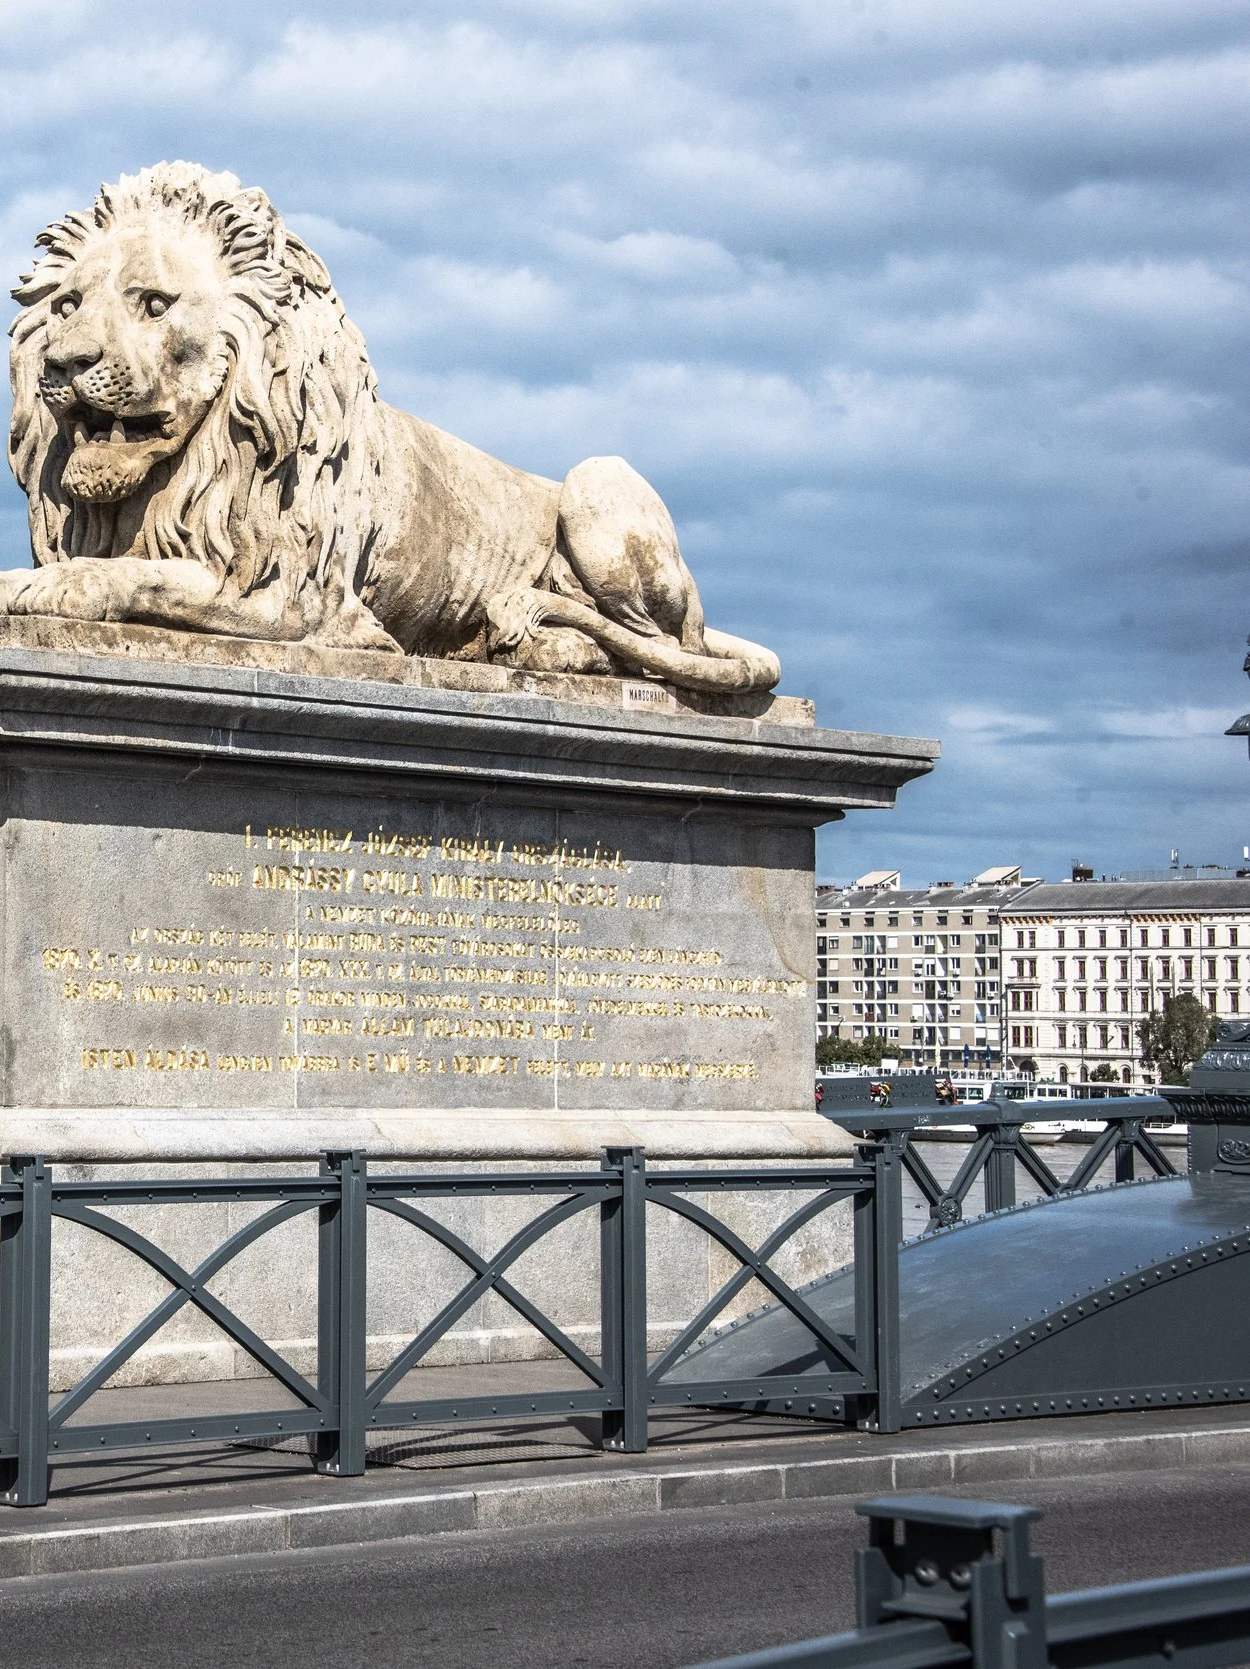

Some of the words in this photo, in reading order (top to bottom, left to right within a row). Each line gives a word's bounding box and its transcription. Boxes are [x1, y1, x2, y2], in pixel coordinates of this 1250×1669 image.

[267, 827, 353, 854] FERENCZ
[362, 824, 433, 859] JÓZSEF
[440, 832, 504, 863] KIRÁLY
[252, 859, 355, 893] ANDRÁSSY
[362, 869, 423, 896] GYULA
[431, 872, 619, 908] MINISTERELNÖKSÉGE
[305, 905, 315, 921] A
[320, 906, 375, 923] NEMZET
[131, 927, 149, 943] AZ
[153, 922, 205, 945] ORSZÁG
[209, 924, 234, 947] KÉT
[349, 932, 386, 952] BUDA
[389, 932, 406, 952] ÉS
[409, 935, 447, 954] PEST
[258, 956, 273, 976] ÉS
[284, 1018, 294, 1035] A
[302, 1017, 353, 1036] MAGYAR
[360, 1011, 415, 1037] ÁLLAM
[82, 1048, 137, 1070] ISTEN
[144, 1044, 210, 1071] ÁLDÁSA
[348, 1056, 361, 1072] IS
[367, 1053, 378, 1073] E
[415, 1050, 432, 1074] ÉS
[437, 1057, 447, 1074] A
[452, 1055, 520, 1075] NEMZET
